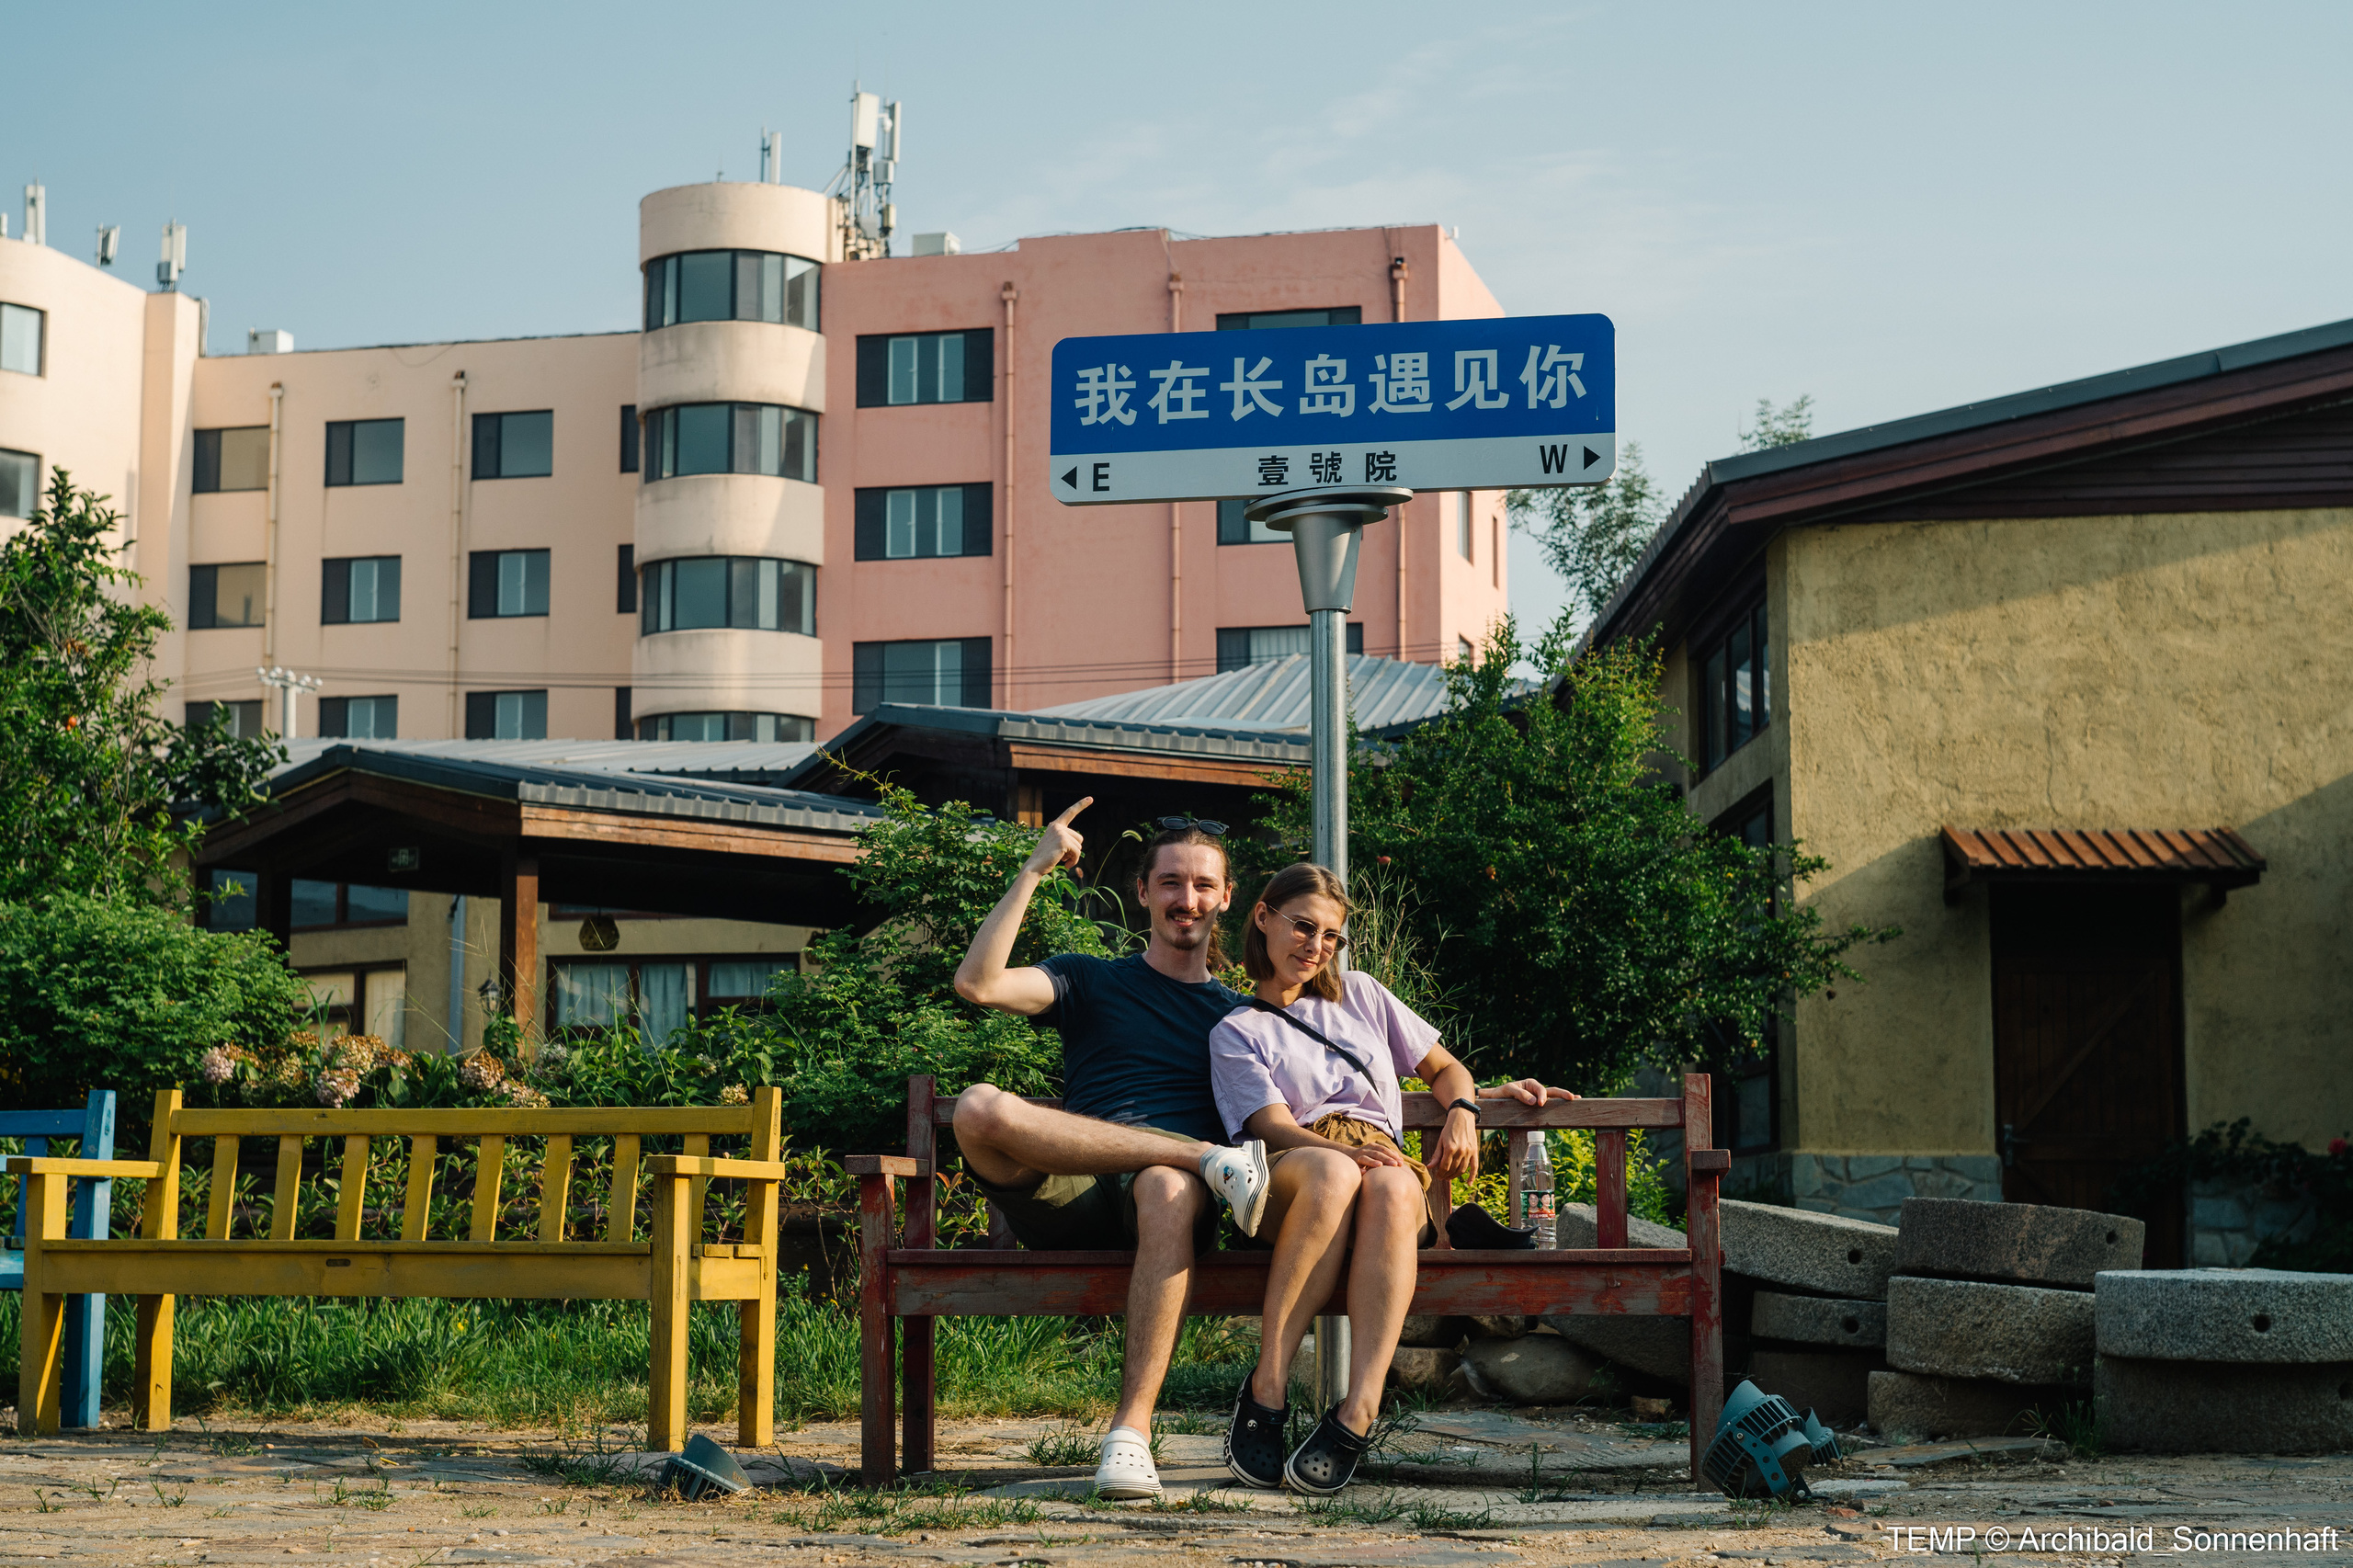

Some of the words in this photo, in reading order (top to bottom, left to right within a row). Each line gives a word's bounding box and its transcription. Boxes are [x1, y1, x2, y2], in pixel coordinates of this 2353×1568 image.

[1074, 344, 1586, 426] 我在长岛遇见你
[1257, 450, 1397, 486] 壹號院
[1539, 444, 1569, 475] W
[1092, 462, 1110, 493] E
